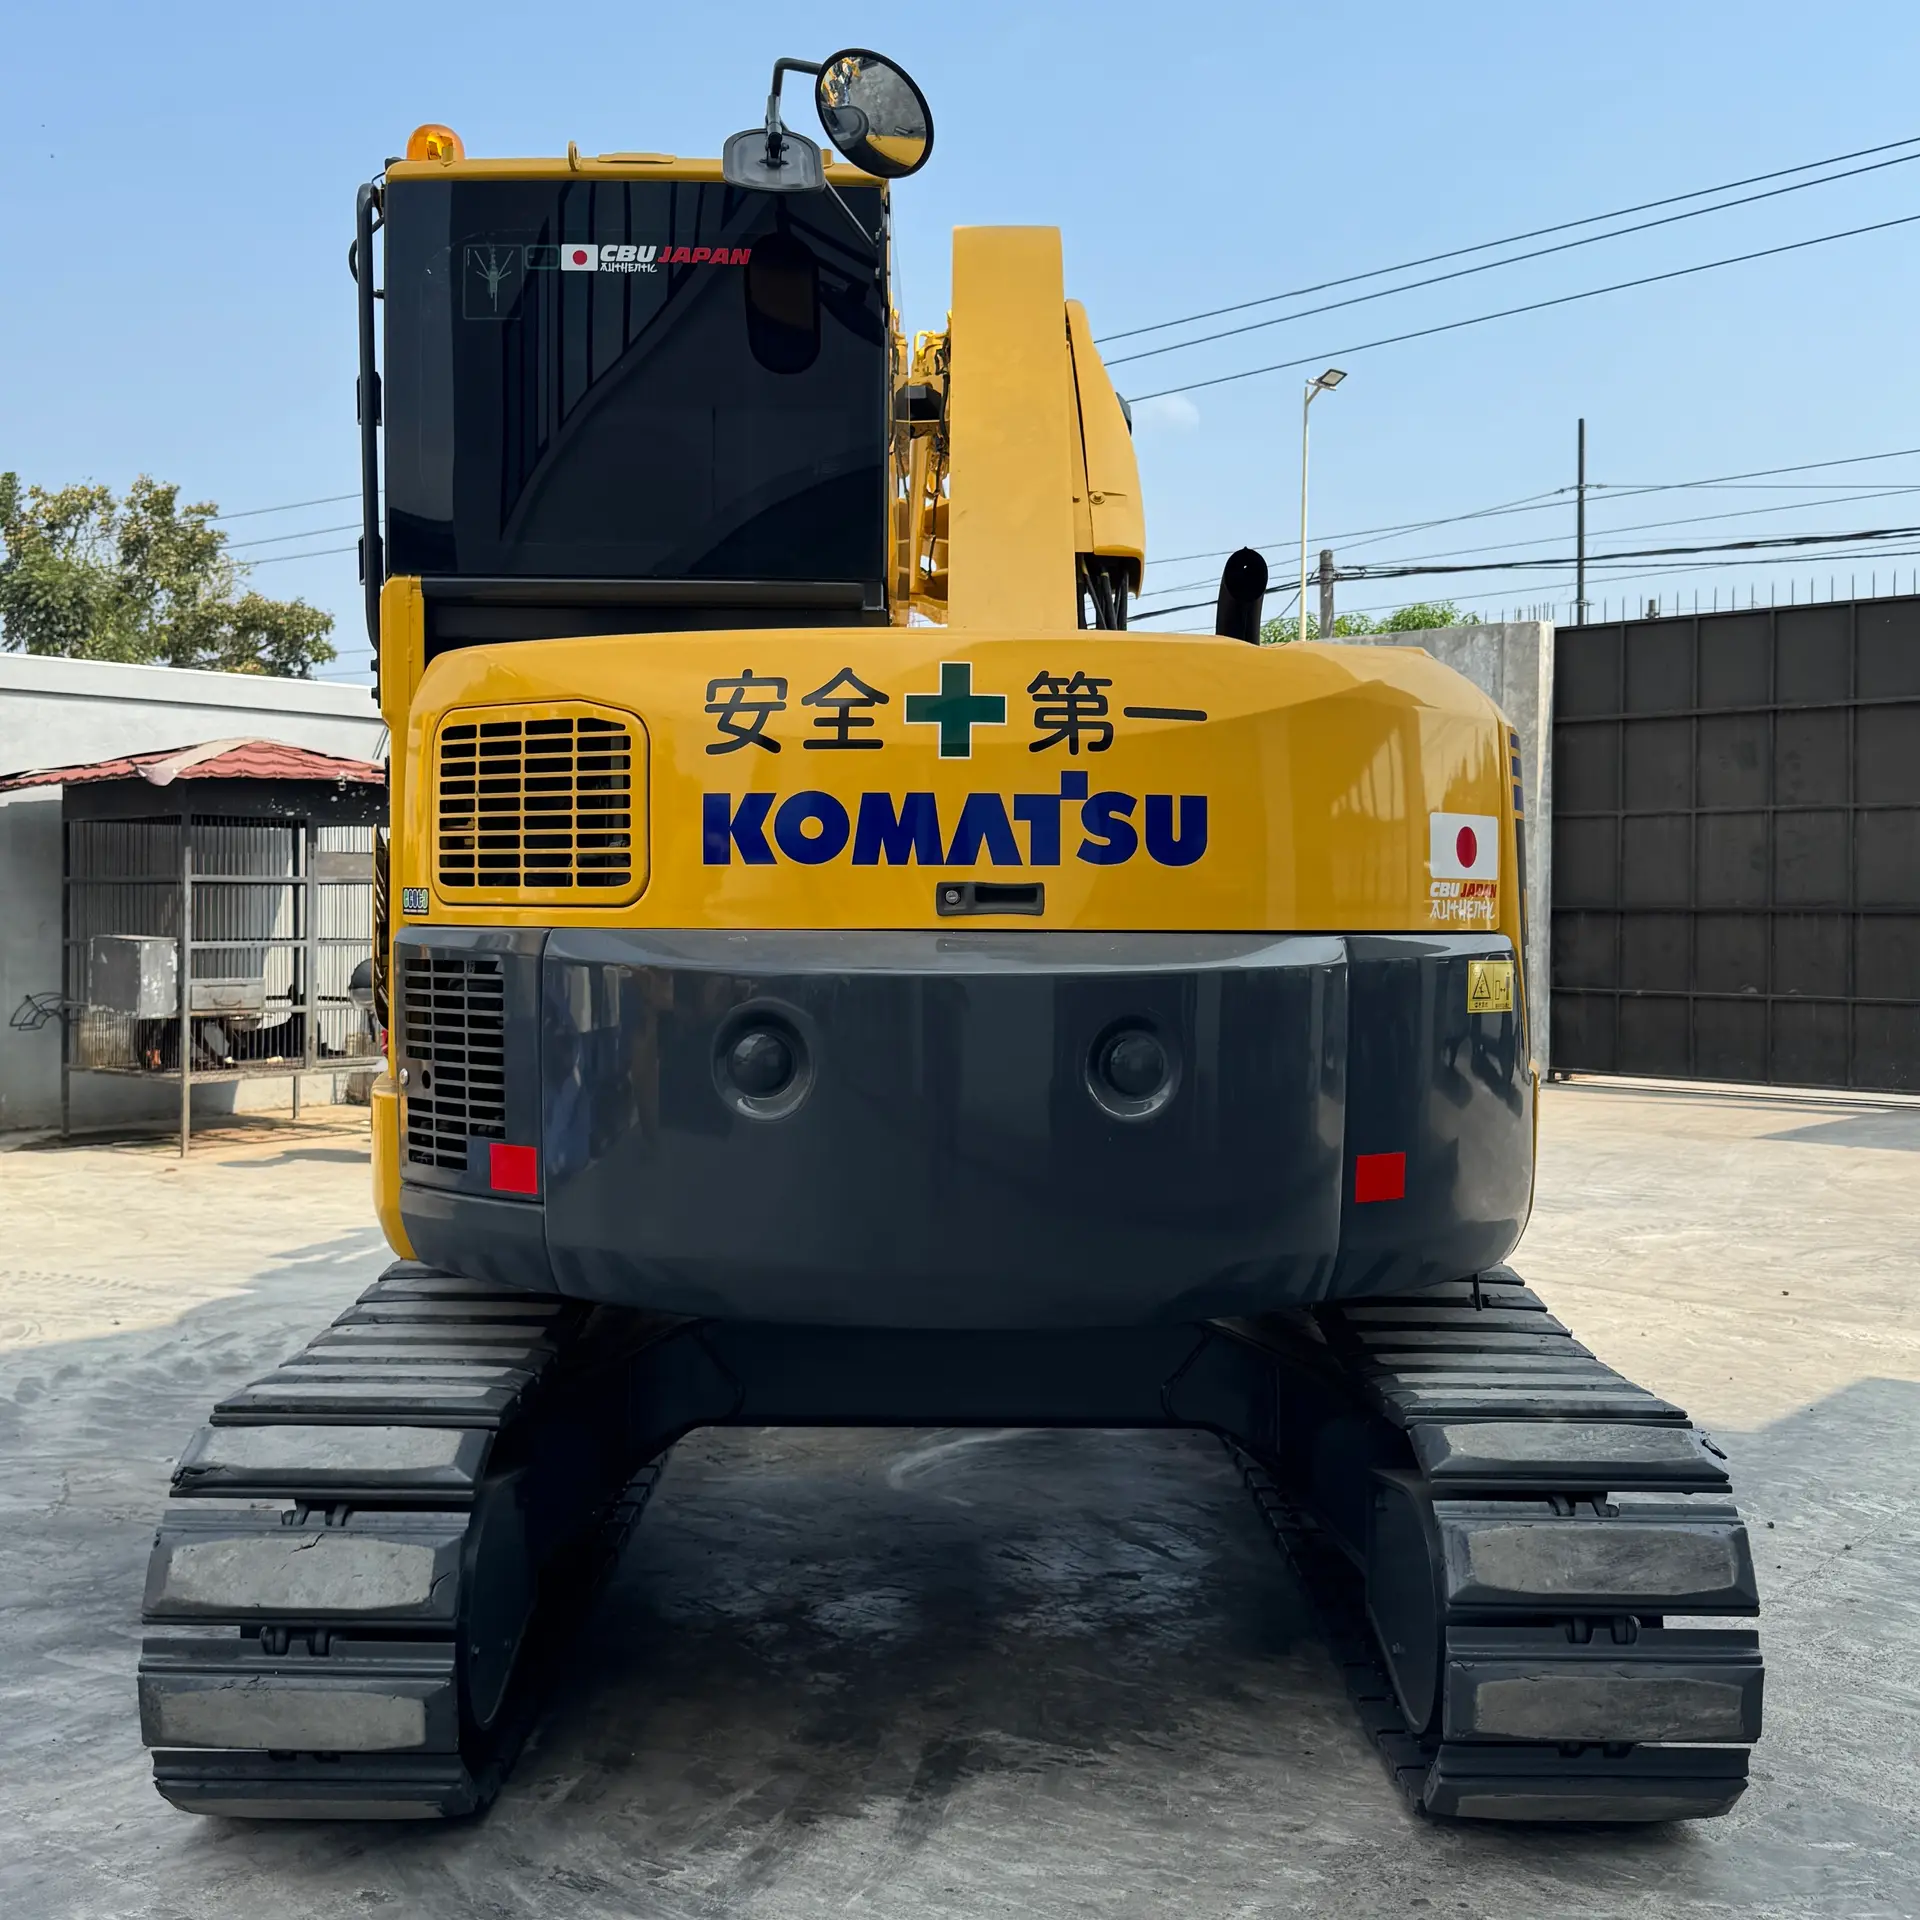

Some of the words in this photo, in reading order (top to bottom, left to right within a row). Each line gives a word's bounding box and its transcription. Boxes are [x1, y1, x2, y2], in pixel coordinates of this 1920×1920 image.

[600, 244, 657, 262] CBU
[658, 246, 752, 265] JAPAN
[600, 262, 658, 273] AUTHENTIC
[704, 667, 890, 756] 安全
[1026, 670, 1208, 756] 第一
[703, 771, 1208, 867] KOMATSU
[1430, 882, 1460, 898] CBU
[1461, 883, 1497, 898] JAPAN
